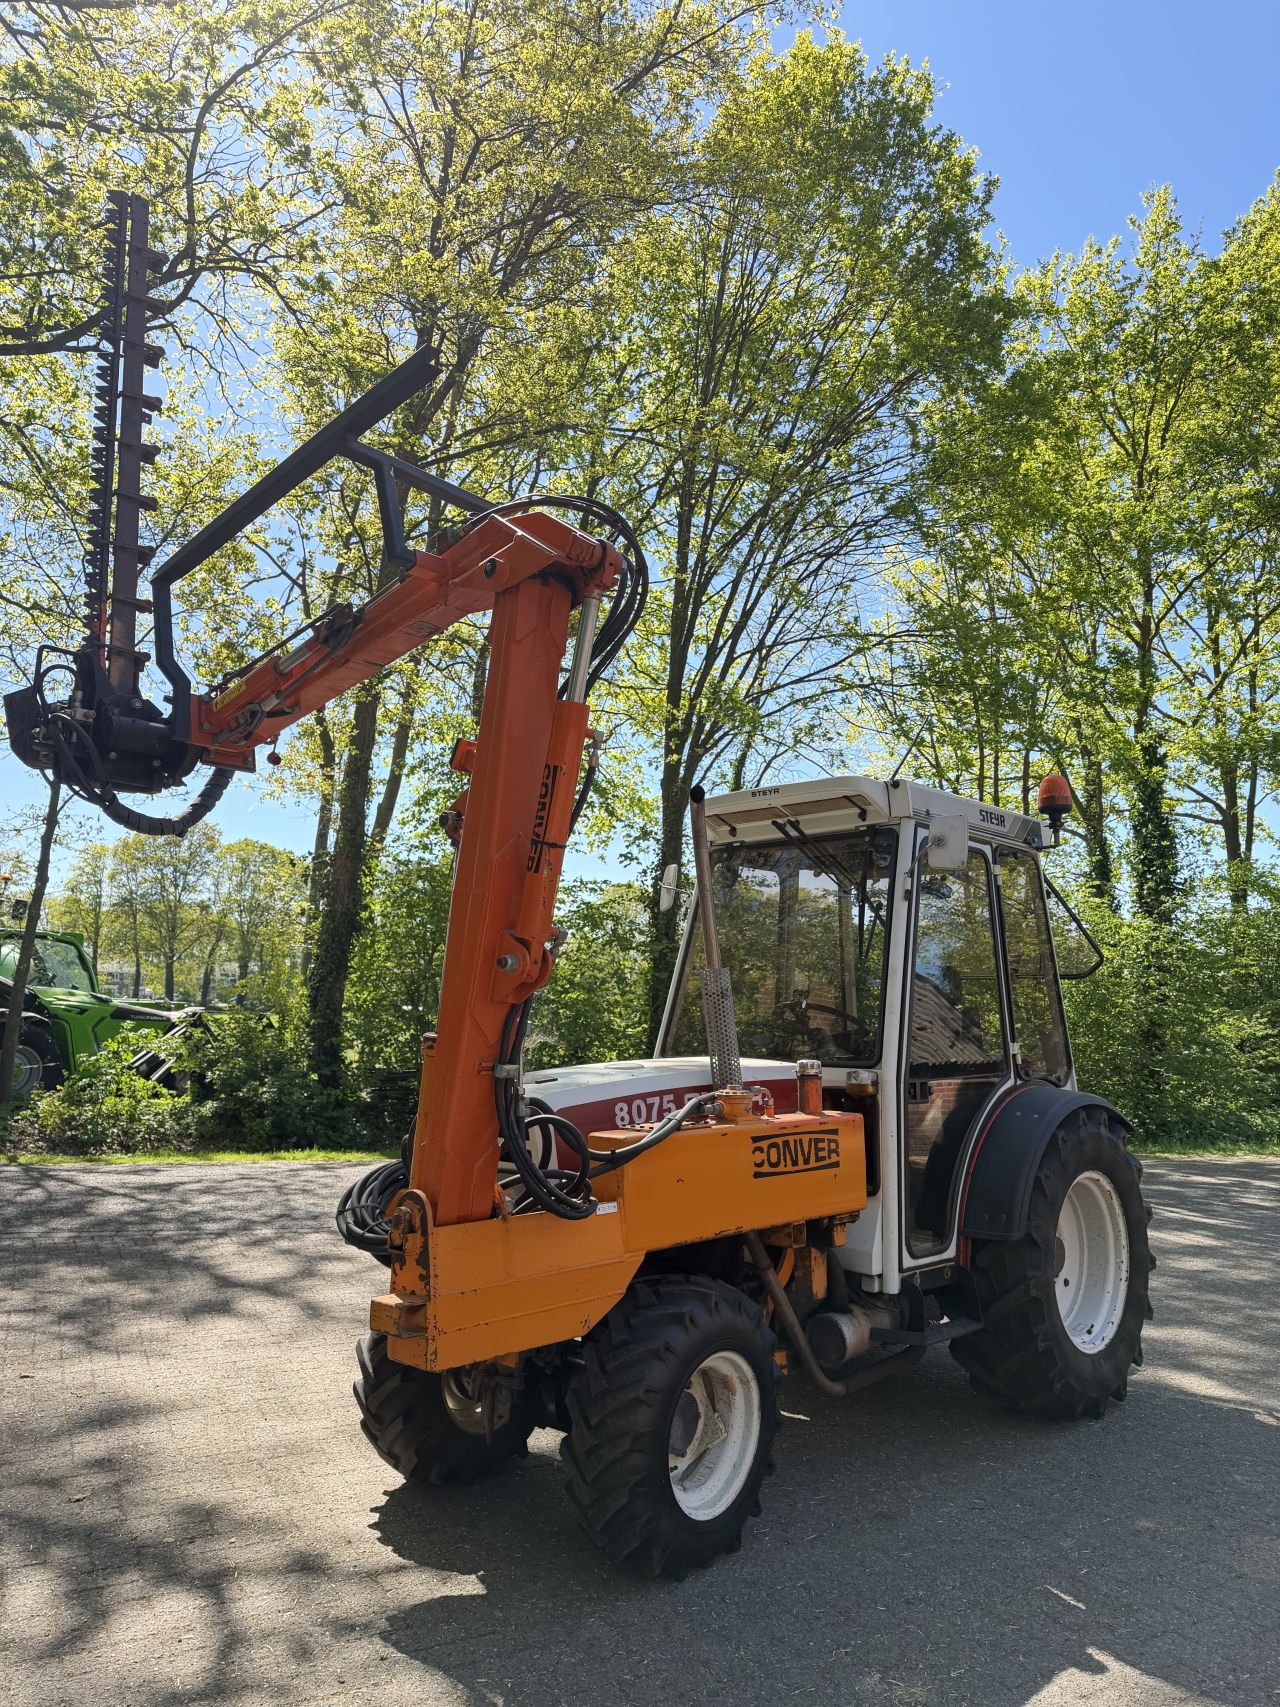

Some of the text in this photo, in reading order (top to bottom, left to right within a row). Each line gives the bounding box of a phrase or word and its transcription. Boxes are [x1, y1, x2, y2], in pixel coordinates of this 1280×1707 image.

[751, 788, 780, 797] STEYR
[979, 809, 1006, 828] STEYR
[615, 1094, 677, 1128] 8075
[752, 1138, 840, 1168] CONVER
